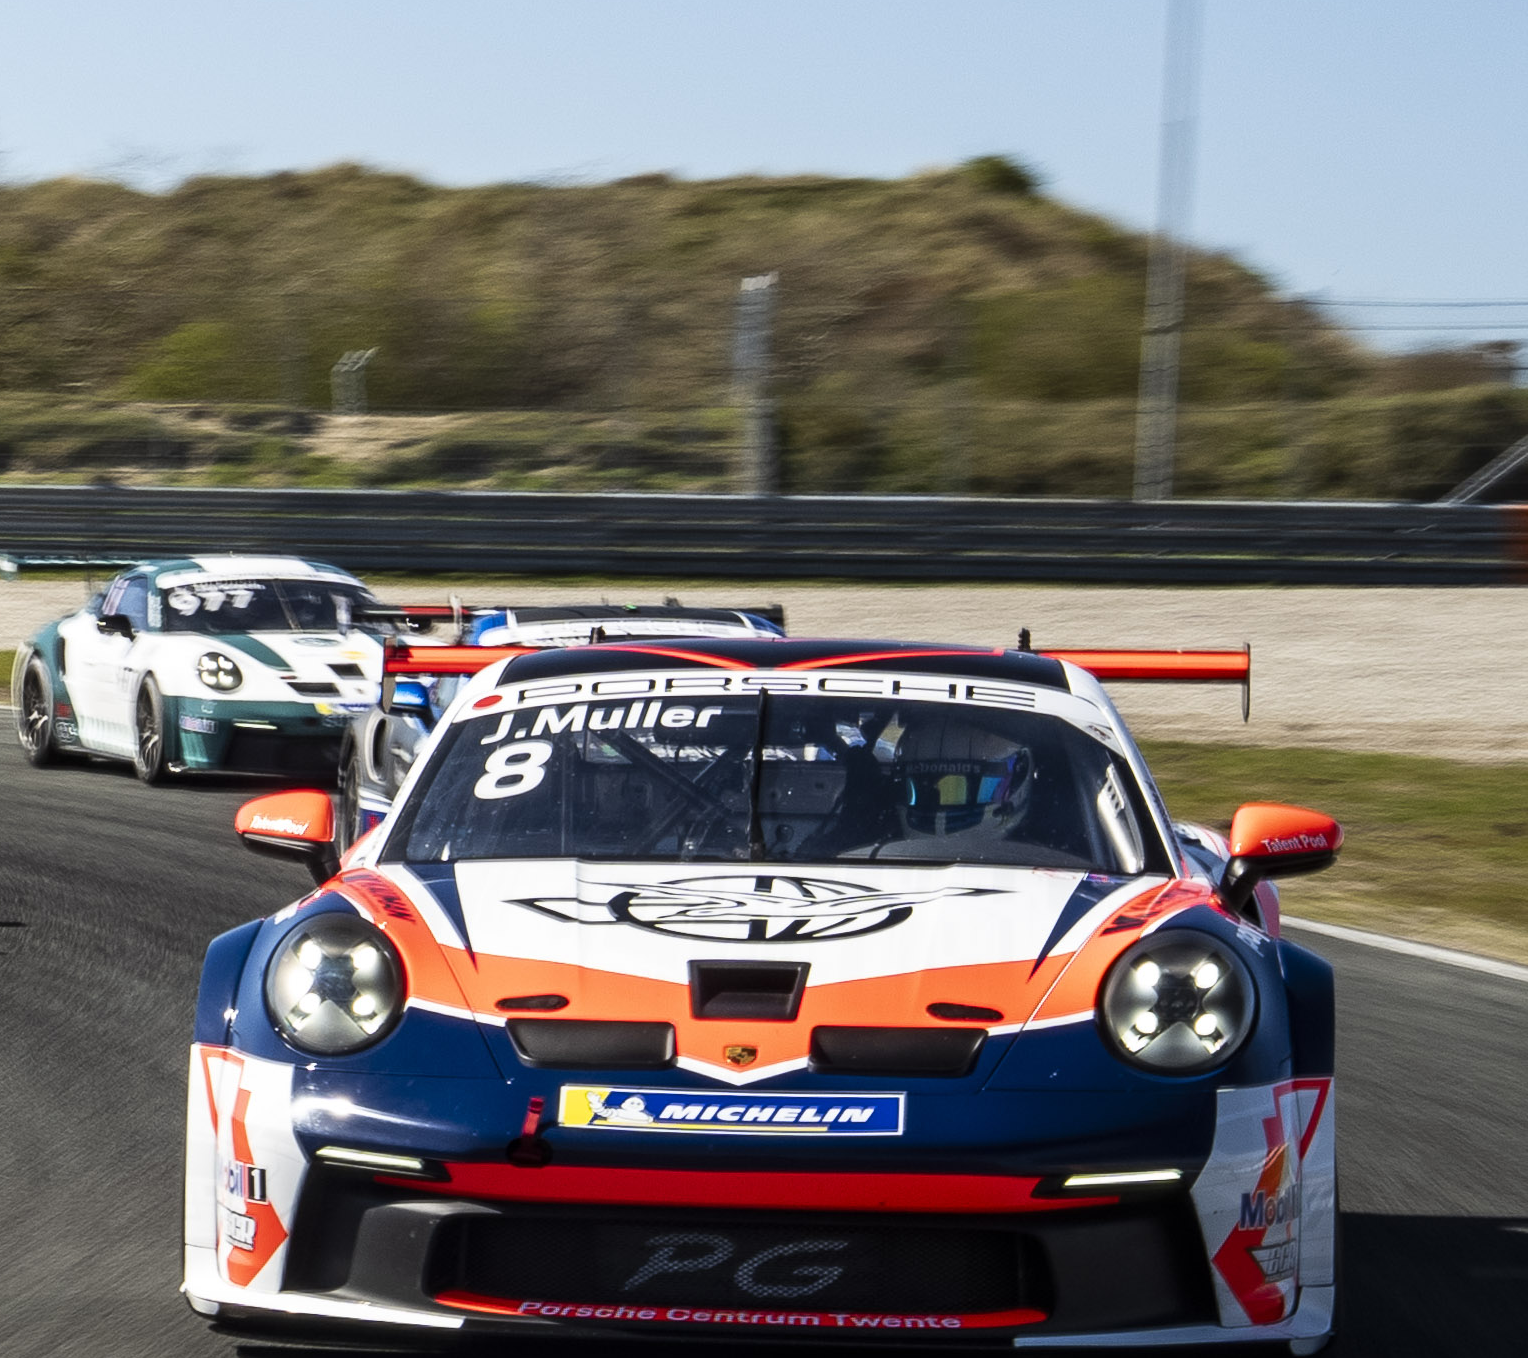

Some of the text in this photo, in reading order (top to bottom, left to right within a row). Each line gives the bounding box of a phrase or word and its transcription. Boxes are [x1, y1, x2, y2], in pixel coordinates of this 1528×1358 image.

[518, 676, 1037, 708] PORSCHE
[473, 740, 553, 800] 8
[1262, 833, 1328, 854] Talent Pool
[658, 1102, 876, 1123] MICHELIN
[622, 1232, 850, 1298] PG
[517, 1301, 962, 1329] Porsche Centrum Twente
